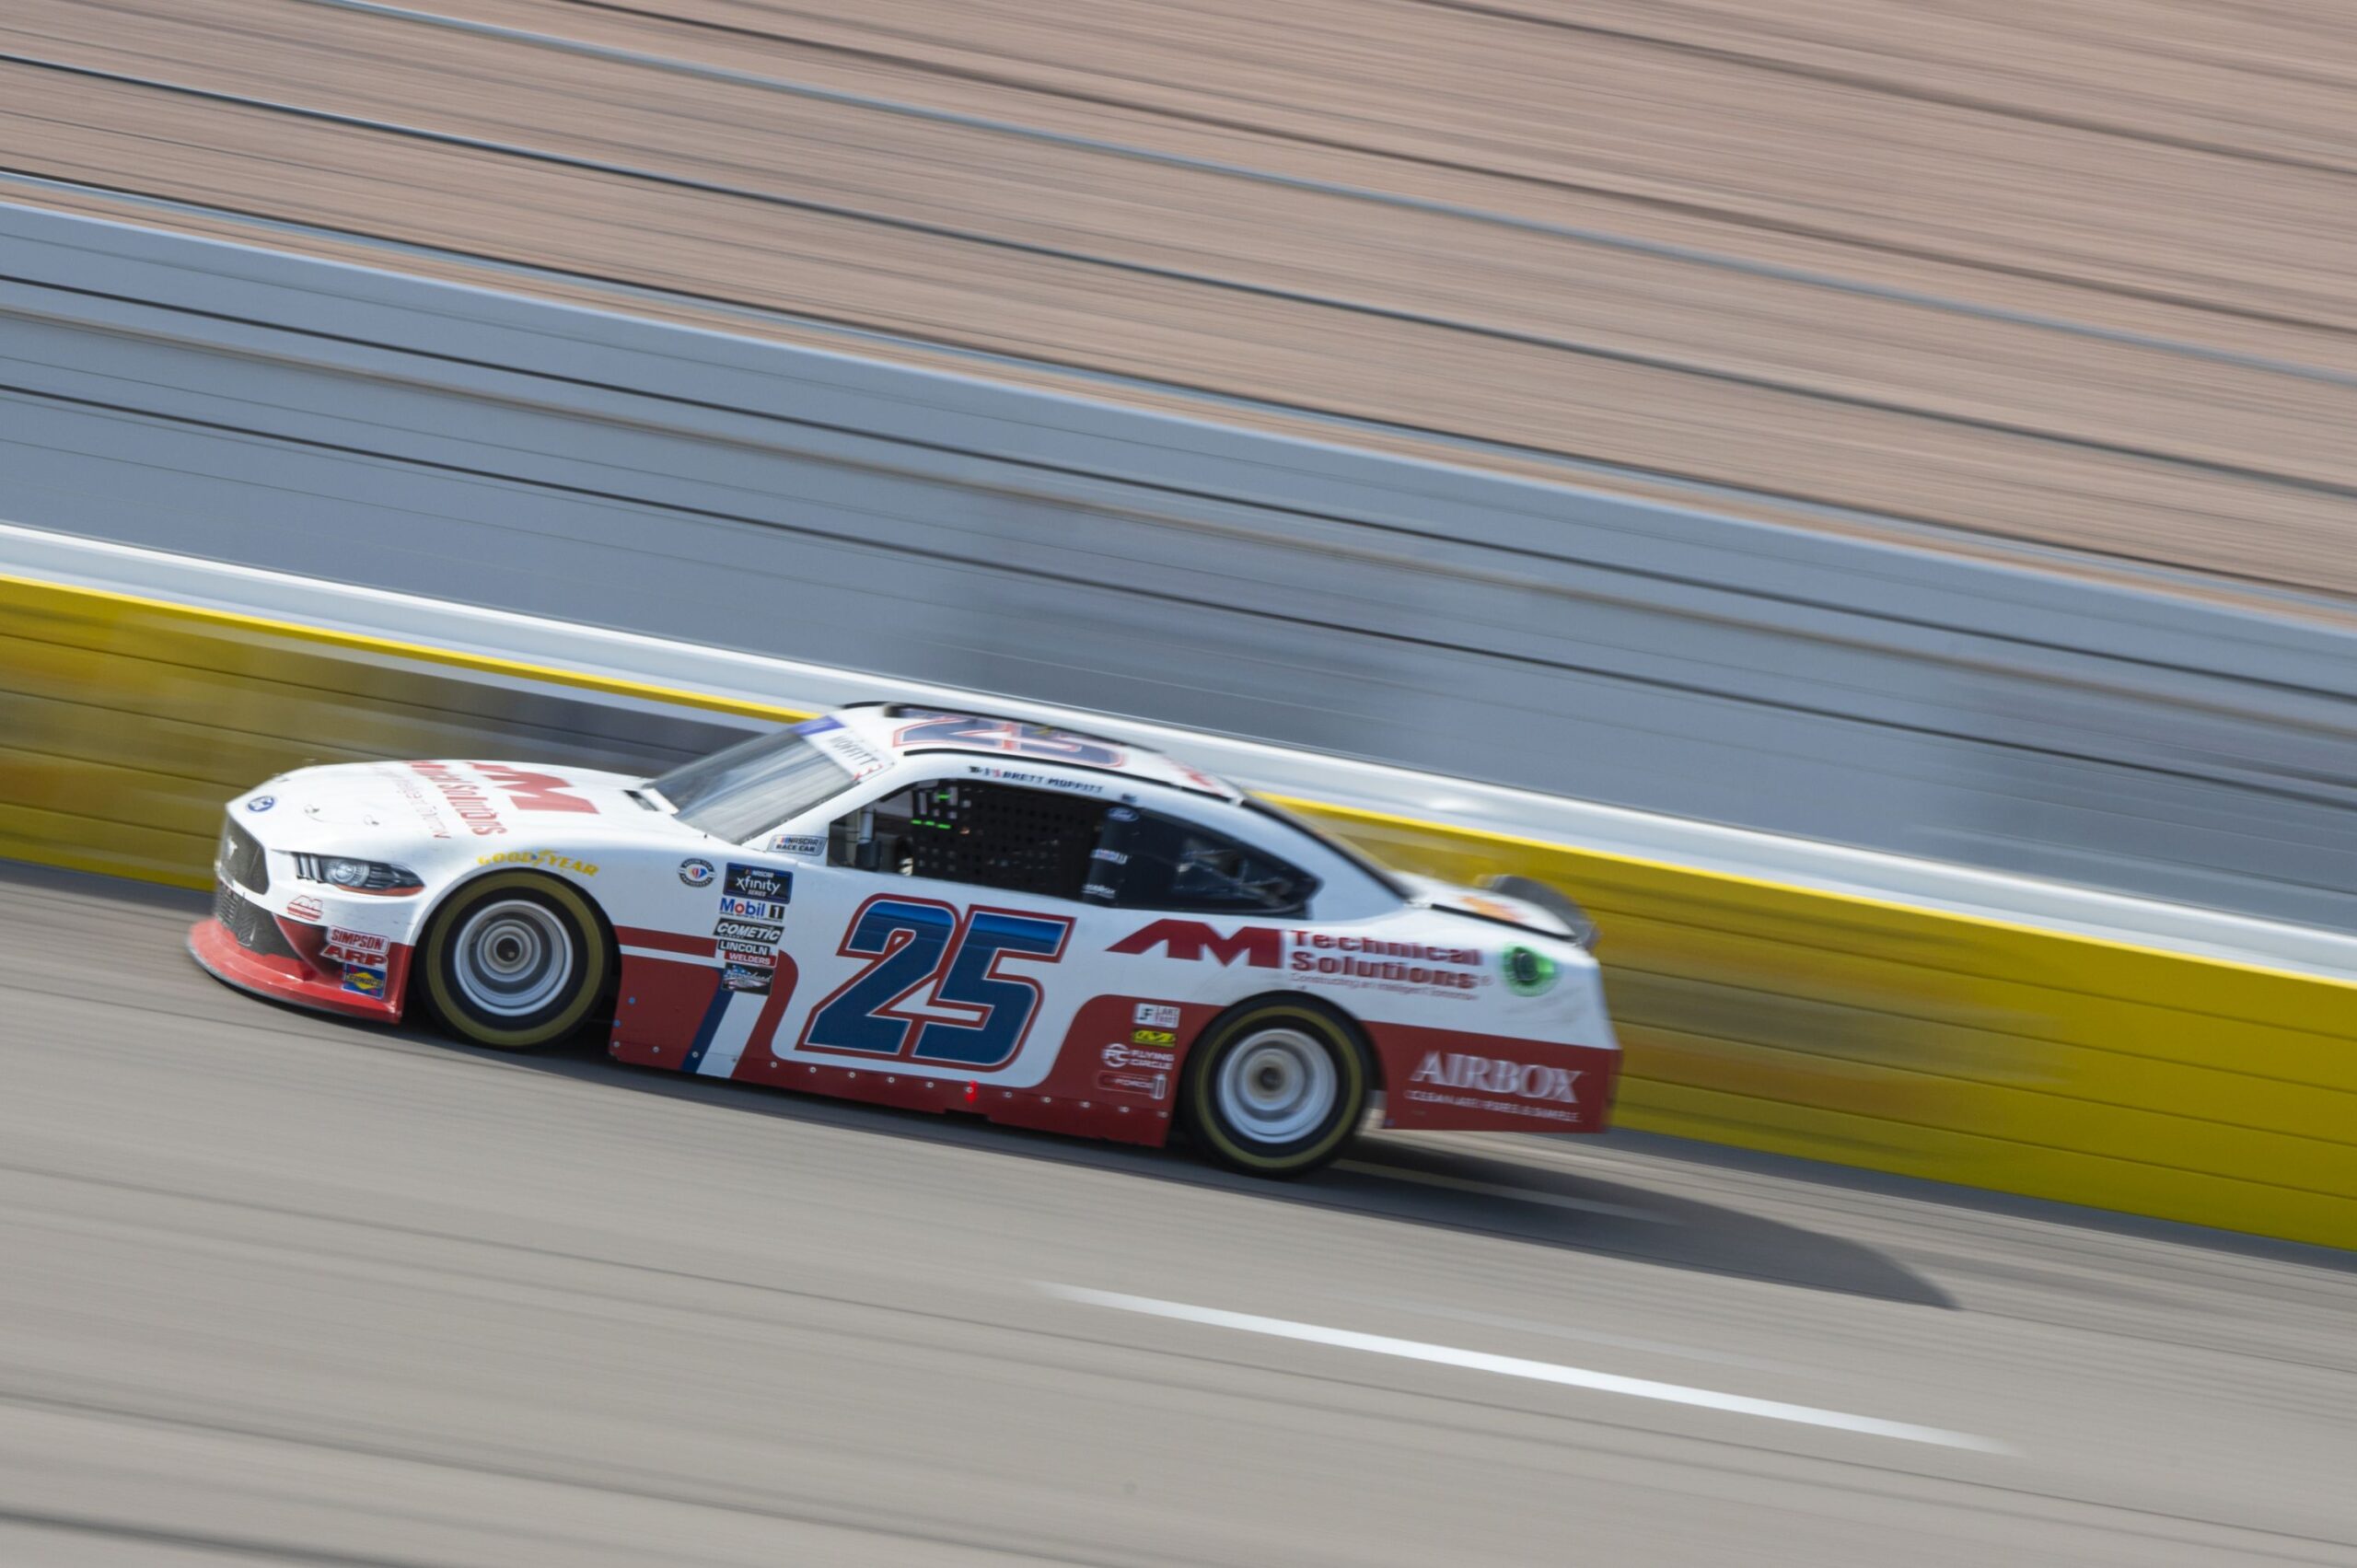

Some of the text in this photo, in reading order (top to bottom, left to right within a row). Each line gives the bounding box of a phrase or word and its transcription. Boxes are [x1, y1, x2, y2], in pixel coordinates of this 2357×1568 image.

[1002, 771, 1105, 794] BRETT MOFFITT
[787, 836, 819, 846] NASCAR
[798, 844, 816, 853] CAR
[735, 877, 782, 895] xfinity
[720, 897, 766, 917] Mobil
[331, 928, 385, 951] SIMPSON
[716, 922, 782, 941] COMETIC
[720, 940, 768, 956] LINCOLN
[1104, 918, 1283, 970] AM
[1290, 928, 1483, 967] Technical
[322, 945, 388, 967] ARP
[728, 951, 771, 966] WELDERS
[795, 892, 1078, 1074] 25
[1409, 1051, 1584, 1104] AIRBOX
